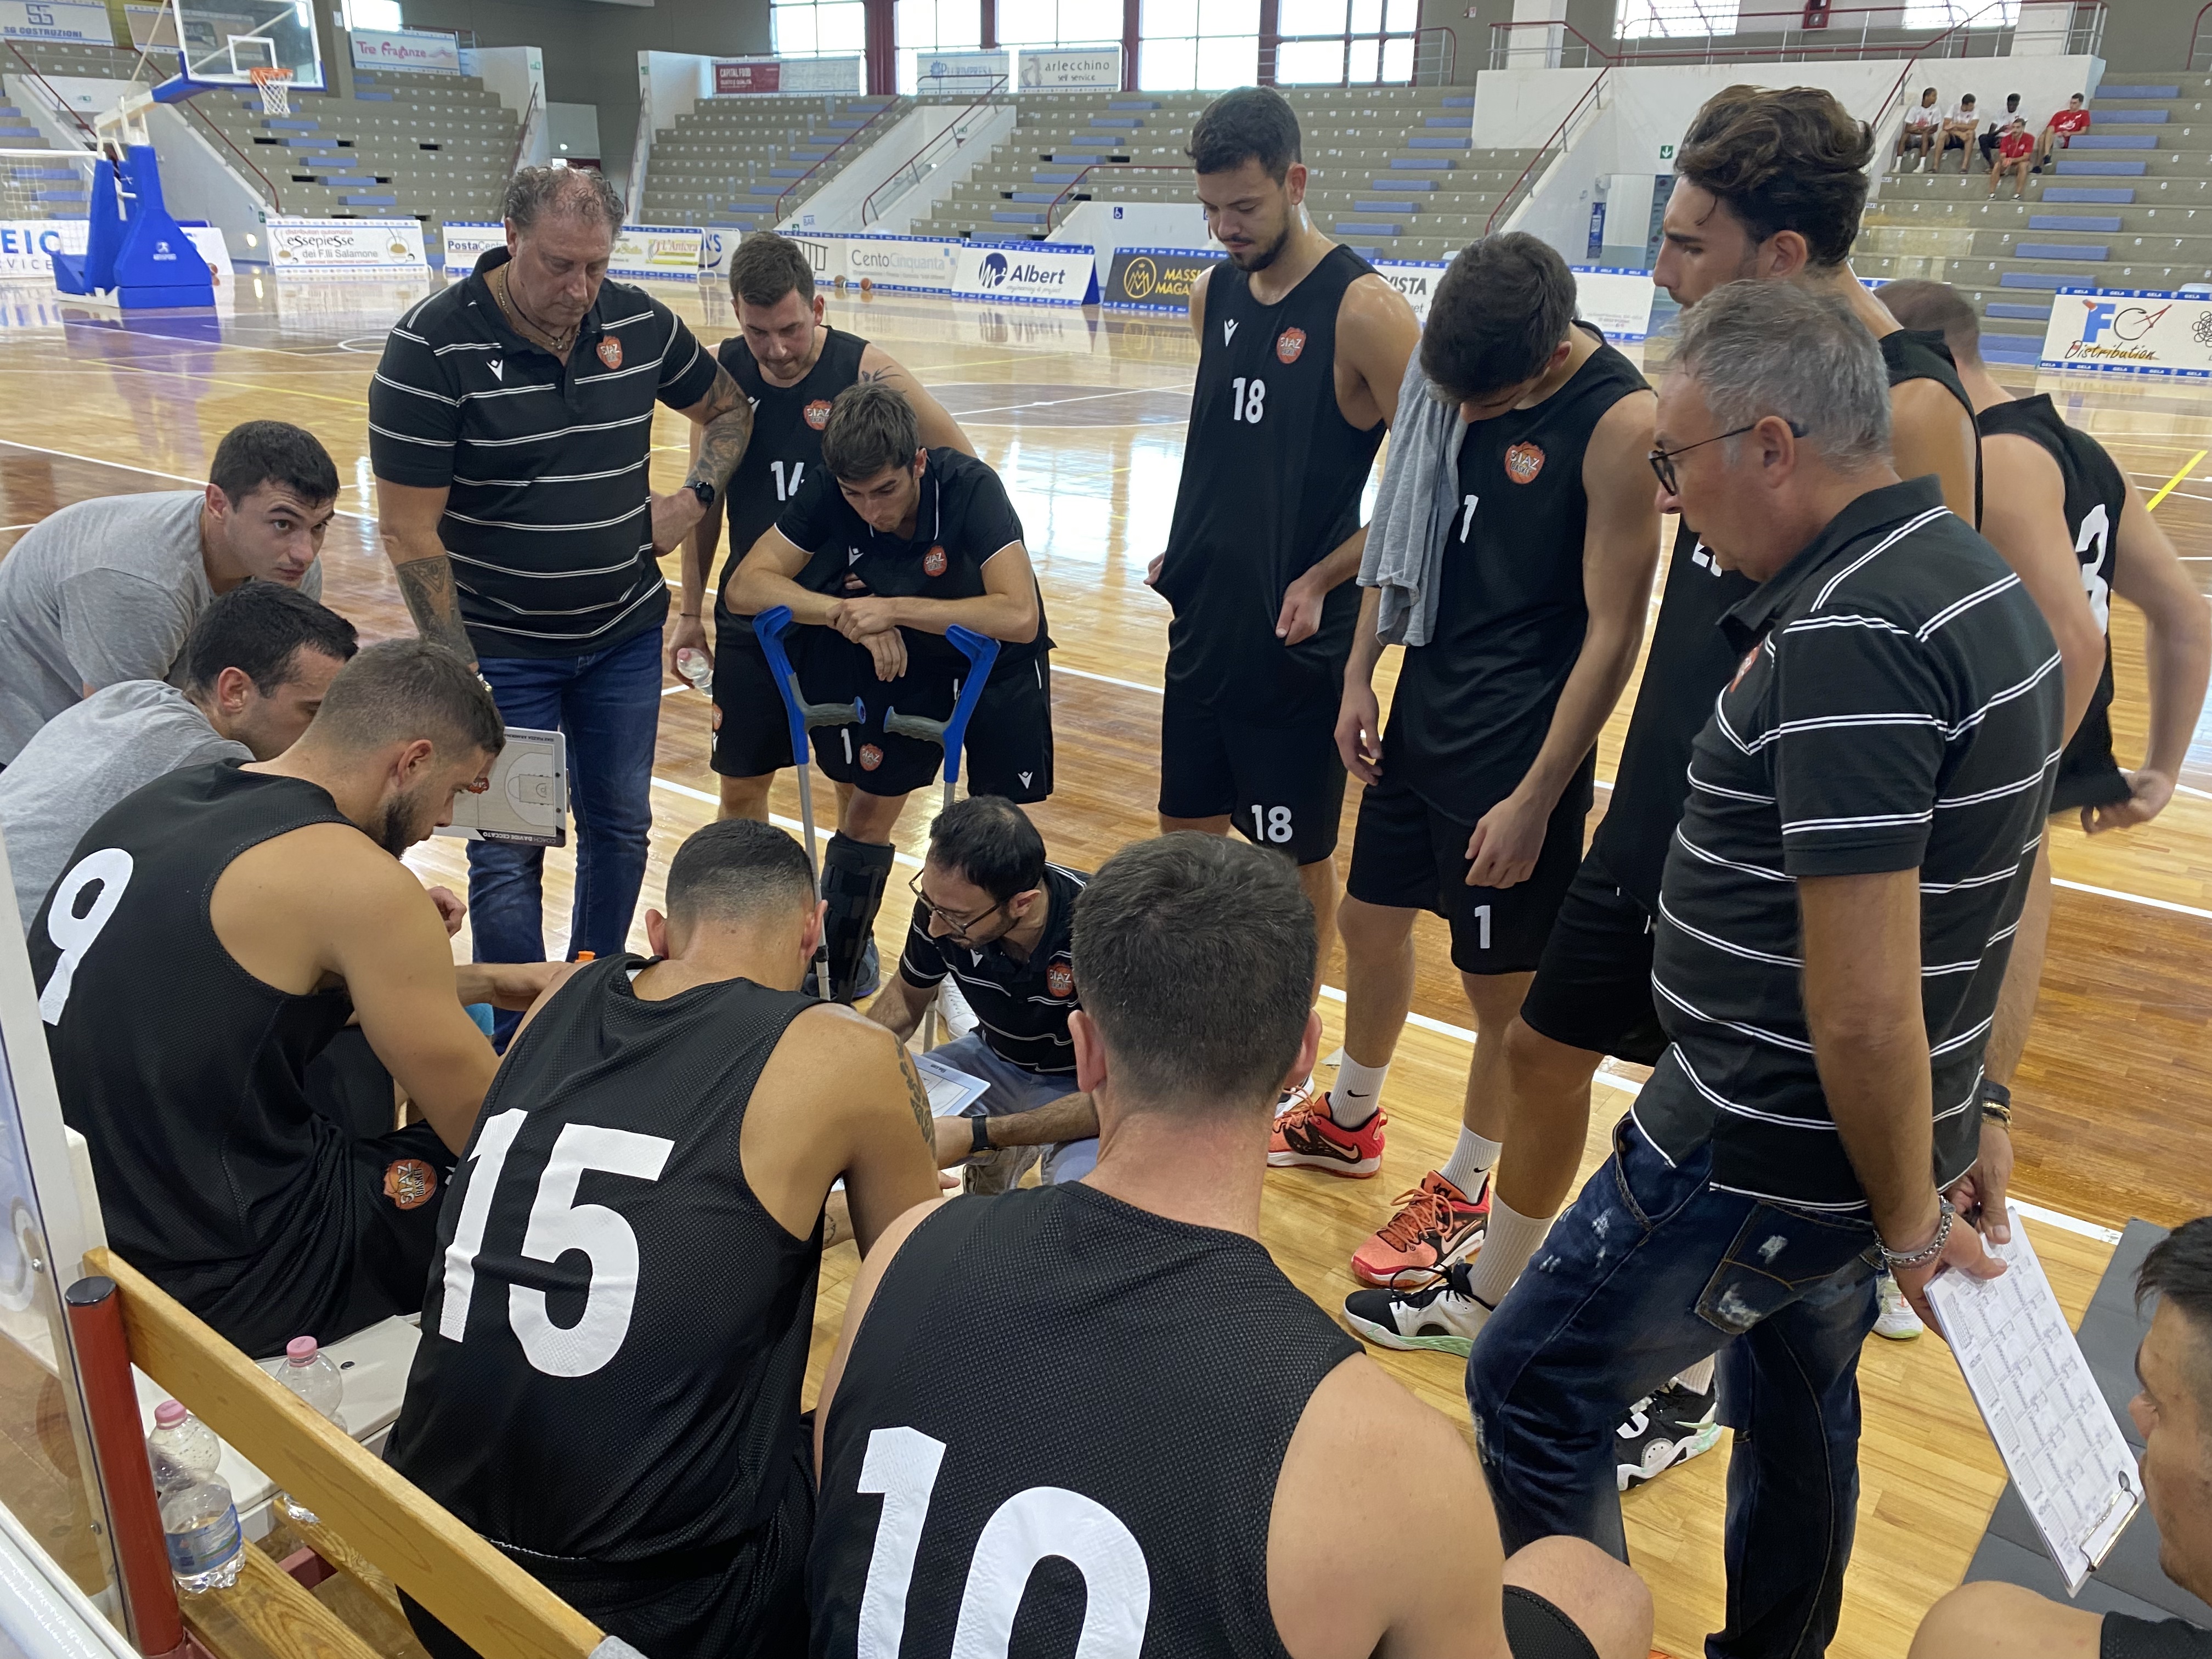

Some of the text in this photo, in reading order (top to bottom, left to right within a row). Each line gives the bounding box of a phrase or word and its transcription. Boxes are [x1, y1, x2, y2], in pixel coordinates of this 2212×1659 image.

[19, 27, 82, 38] COSTRUZIONI
[356, 41, 426, 59] Tre Fraganze
[720, 67, 751, 77] CAPITAL FOOD
[1045, 60, 1110, 71] arlecchino
[1058, 74, 1068, 82] self
[0, 258, 53, 269] VICE
[302, 250, 317, 258] dei
[335, 250, 378, 258] Salamone
[851, 249, 945, 272] CentoCinquanta
[1009, 264, 1065, 285] Albert
[1164, 268, 1203, 282] MASSI
[1280, 337, 1302, 349] SIAZ
[2065, 341, 2156, 360] Distribution
[1232, 377, 1266, 424] 18
[1510, 461, 1531, 477] BASKET
[1511, 449, 1540, 470] SIAZ
[1459, 494, 1479, 544] 1
[1251, 804, 1293, 843] 18
[40, 848, 133, 1025] 9
[1475, 905, 1491, 949] 1
[397, 1163, 415, 1204] SIAZ
[413, 1168, 425, 1197] BASKET
[438, 1107, 675, 1377] 15
[857, 1426, 1151, 1659] 10
